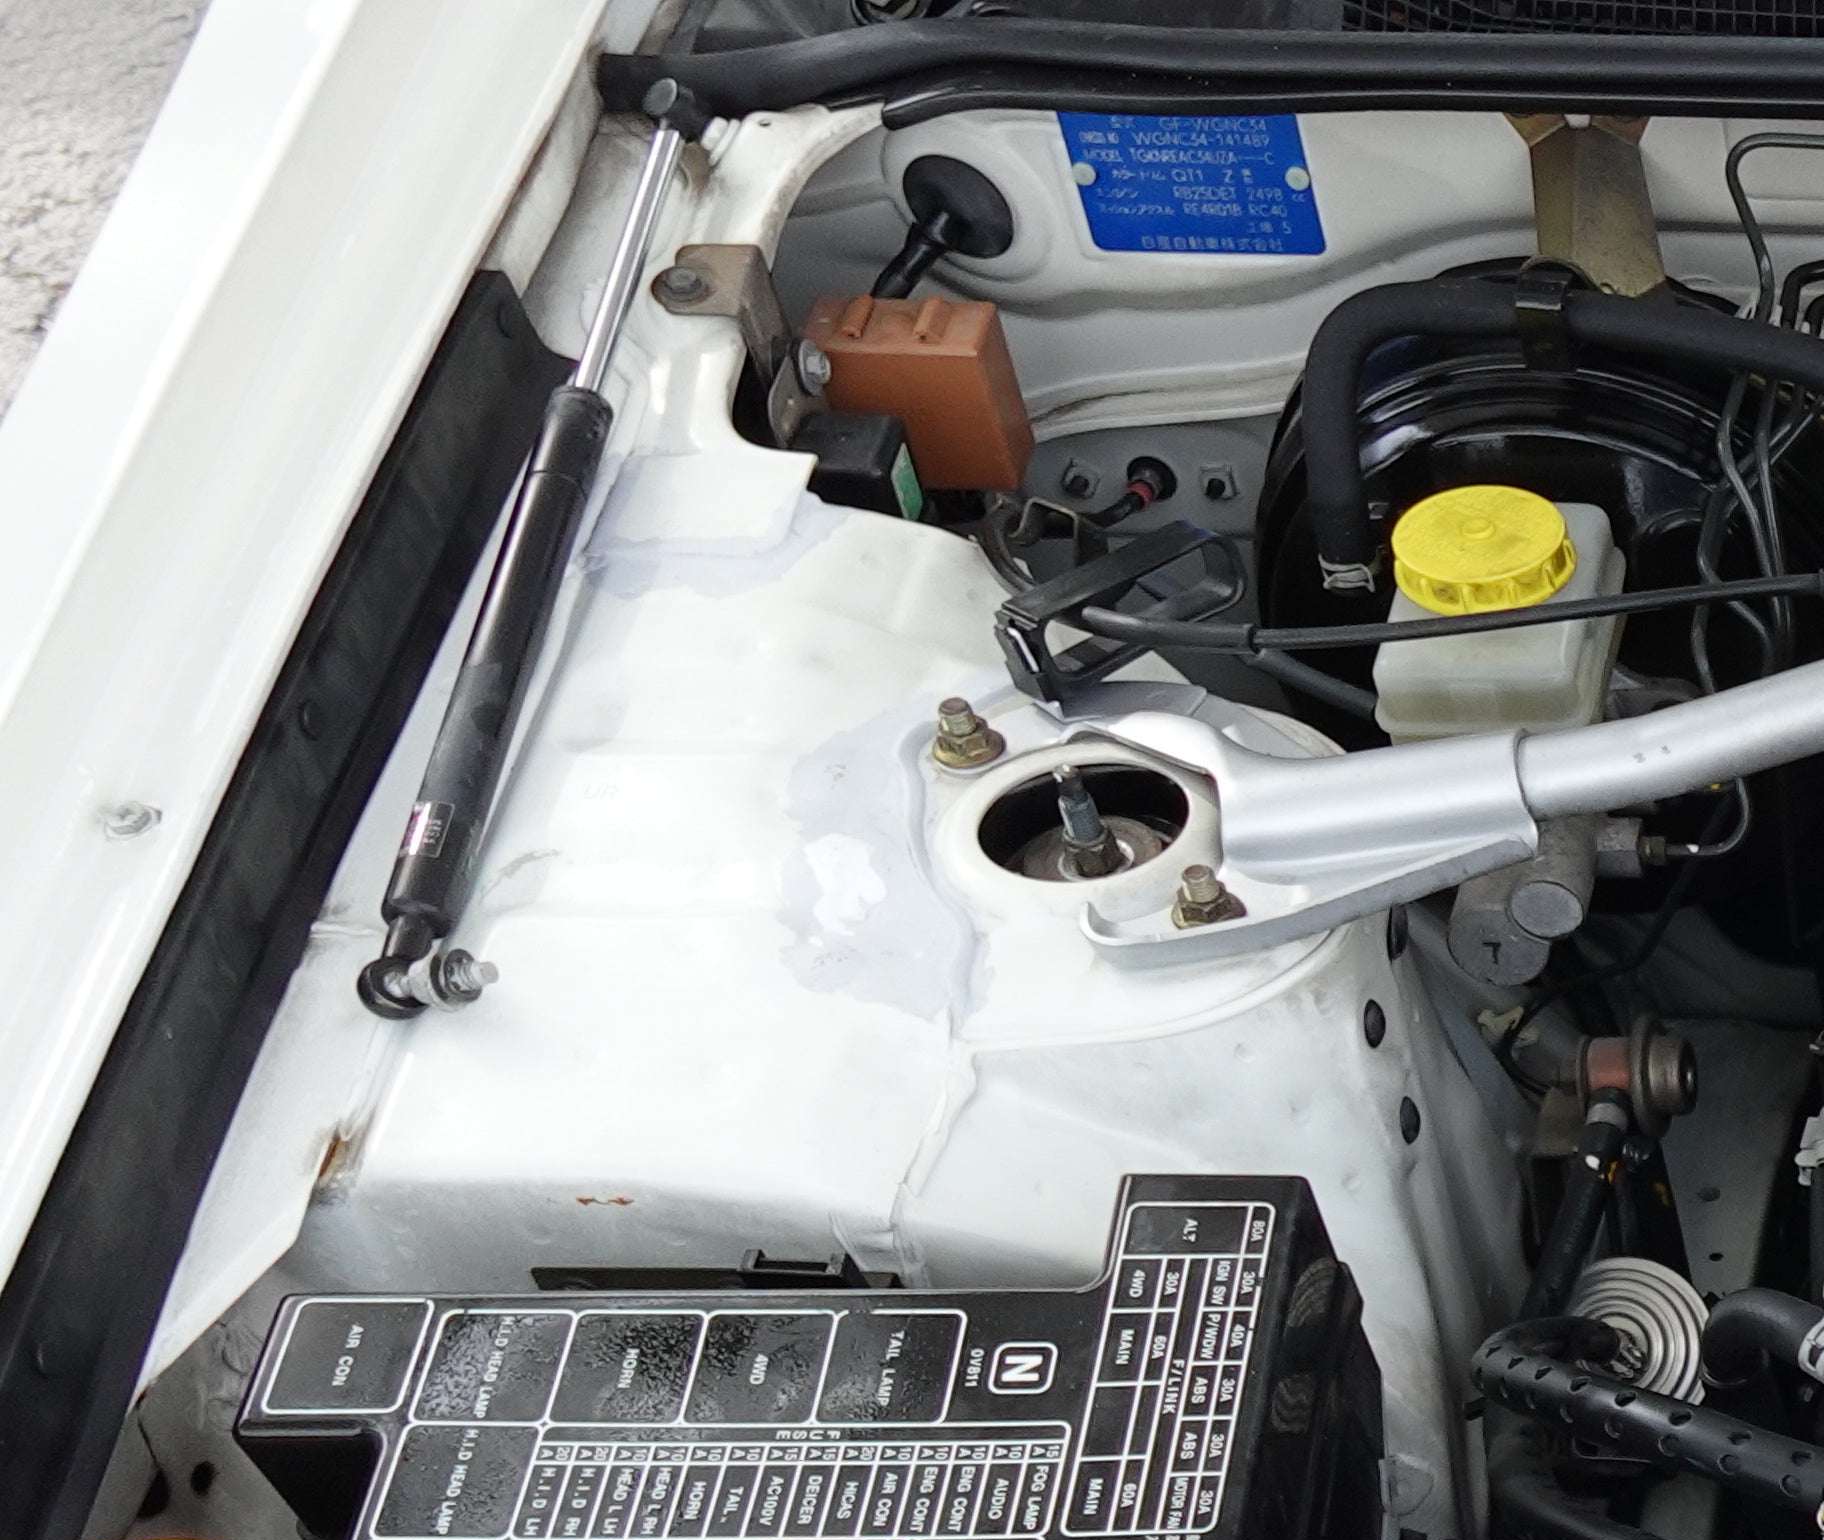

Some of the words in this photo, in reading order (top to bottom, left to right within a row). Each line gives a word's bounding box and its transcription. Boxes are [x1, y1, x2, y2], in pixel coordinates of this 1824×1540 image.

[1251, 1219, 1266, 1242] 80A
[1129, 1269, 1146, 1298] 4WD
[1164, 1271, 1179, 1296] 30A
[1215, 1260, 1231, 1282] IGN
[1241, 1271, 1256, 1295] 30A
[1211, 1285, 1227, 1305] SW
[350, 1325, 364, 1350] AIR
[888, 1330, 905, 1361] TAIL
[1115, 1328, 1135, 1365] MAIN
[1151, 1335, 1167, 1360] 60A
[1201, 1313, 1221, 1360] P/WDW
[1230, 1323, 1245, 1348] 40A
[331, 1355, 354, 1387] CON
[487, 1351, 505, 1384] HEAD
[617, 1347, 638, 1389] HORN
[749, 1352, 768, 1385] 4WD
[1001, 1354, 1043, 1382] N
[878, 1367, 896, 1406] LAMP
[1162, 1359, 1185, 1415] F/LINK
[1191, 1376, 1209, 1404] ABS
[1220, 1377, 1235, 1403] 30A
[476, 1386, 494, 1419] LAMP
[460, 1429, 479, 1462] H.I.D
[775, 1429, 842, 1440] FUSE
[1179, 1431, 1198, 1460] ABS
[1209, 1433, 1224, 1458] 30A
[448, 1464, 467, 1498] HEAD
[532, 1467, 557, 1509] H.I.D
[571, 1467, 596, 1509] H.I.D
[613, 1468, 634, 1501] HEAD
[651, 1467, 672, 1500] HEAD
[881, 1471, 899, 1494] AIR
[920, 1465, 939, 1494] ENG
[957, 1465, 976, 1493] ENG
[1031, 1465, 1049, 1493] FOG
[1170, 1477, 1189, 1509] MOTOR
[608, 1505, 623, 1513] L
[647, 1503, 661, 1512] L
[684, 1480, 707, 1521] HORN
[724, 1486, 744, 1515] TAIL
[759, 1475, 785, 1527] AC100V
[797, 1475, 823, 1525] DEICER
[836, 1481, 859, 1520] HICAS
[987, 1477, 1010, 1520] AUDIO
[1083, 1478, 1104, 1515] MAIN
[1120, 1482, 1137, 1508] 60A
[1198, 1490, 1214, 1515] 30A
[436, 1501, 455, 1535] LAMP
[523, 1517, 541, 1536] LH
[563, 1517, 581, 1536] RH
[602, 1517, 619, 1535] LH
[641, 1517, 658, 1535] RH
[873, 1498, 893, 1527] CON
[909, 1498, 930, 1533] CONT
[947, 1498, 968, 1533] CONT
[1022, 1497, 1042, 1531] LAMP
[1166, 1508, 1183, 1530] FAN
